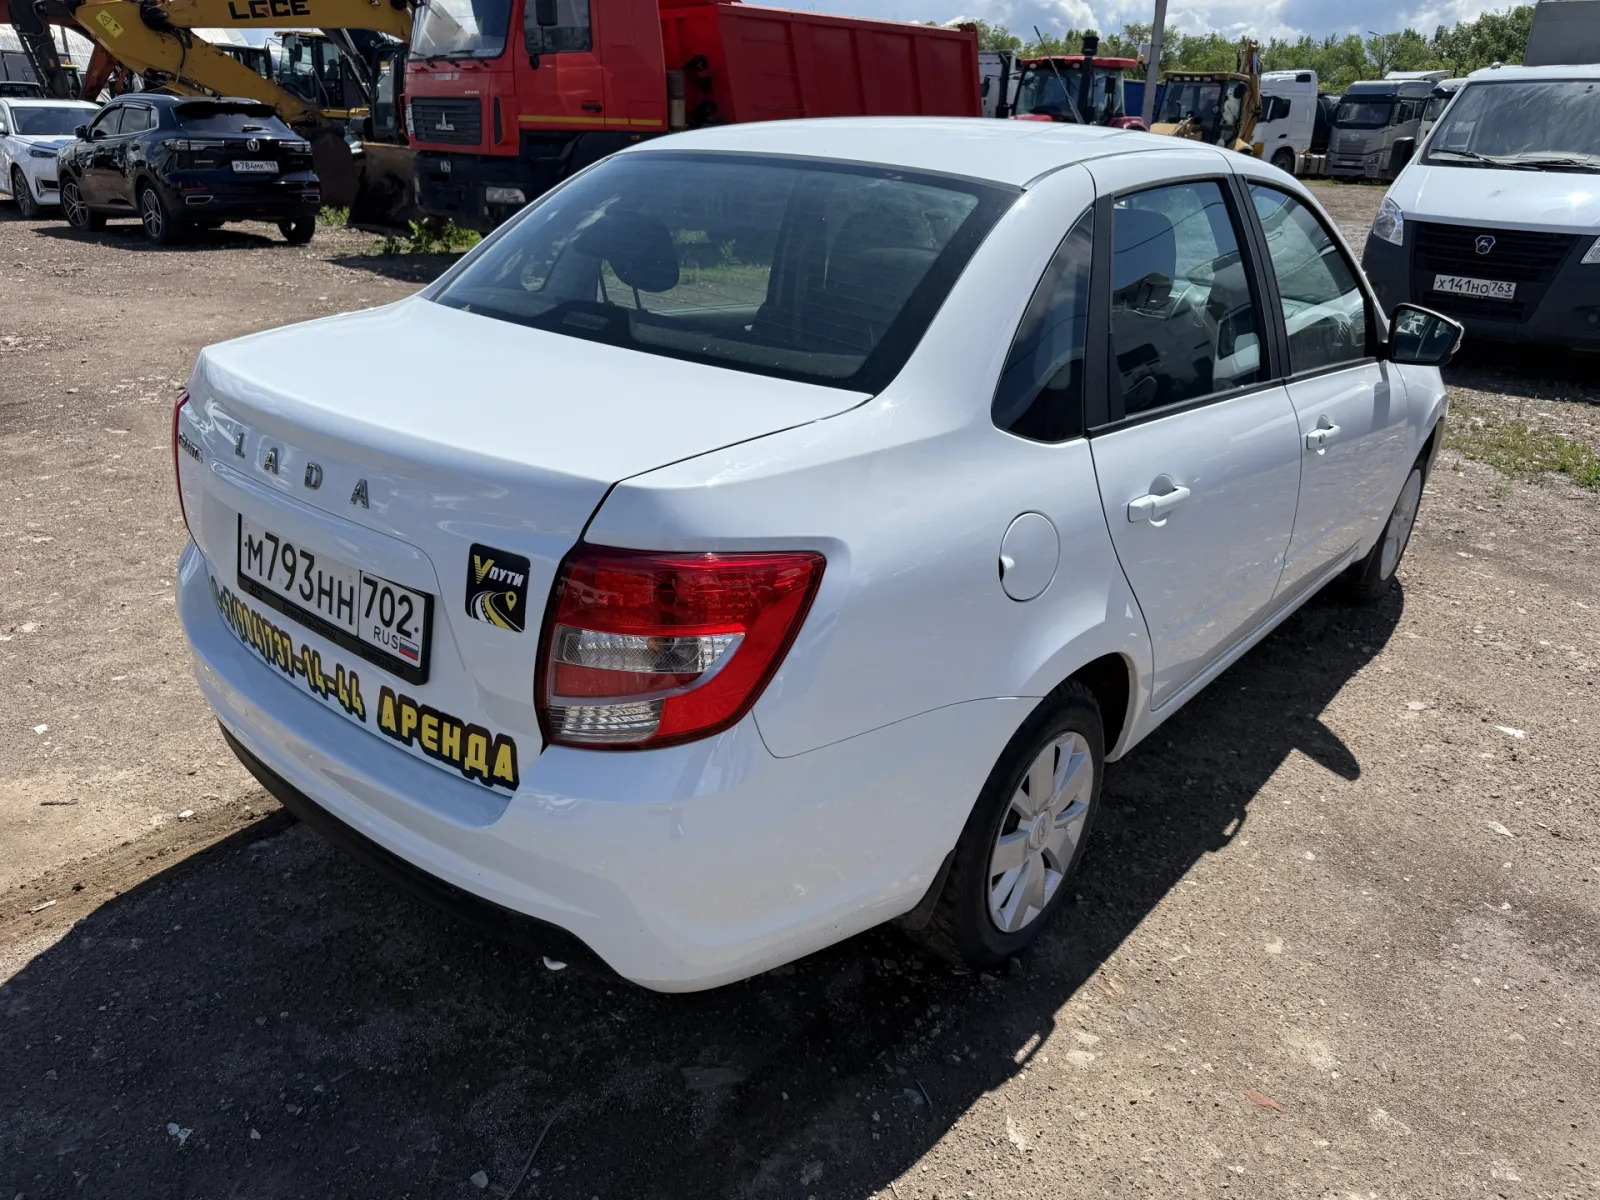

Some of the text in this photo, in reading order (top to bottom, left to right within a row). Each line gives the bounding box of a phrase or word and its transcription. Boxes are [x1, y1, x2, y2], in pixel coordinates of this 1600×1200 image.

[228, 0, 311, 19] LGCE
[235, 432, 370, 510] LADA
[373, 625, 399, 650] RUS
[379, 690, 516, 786] АРЕНДА
